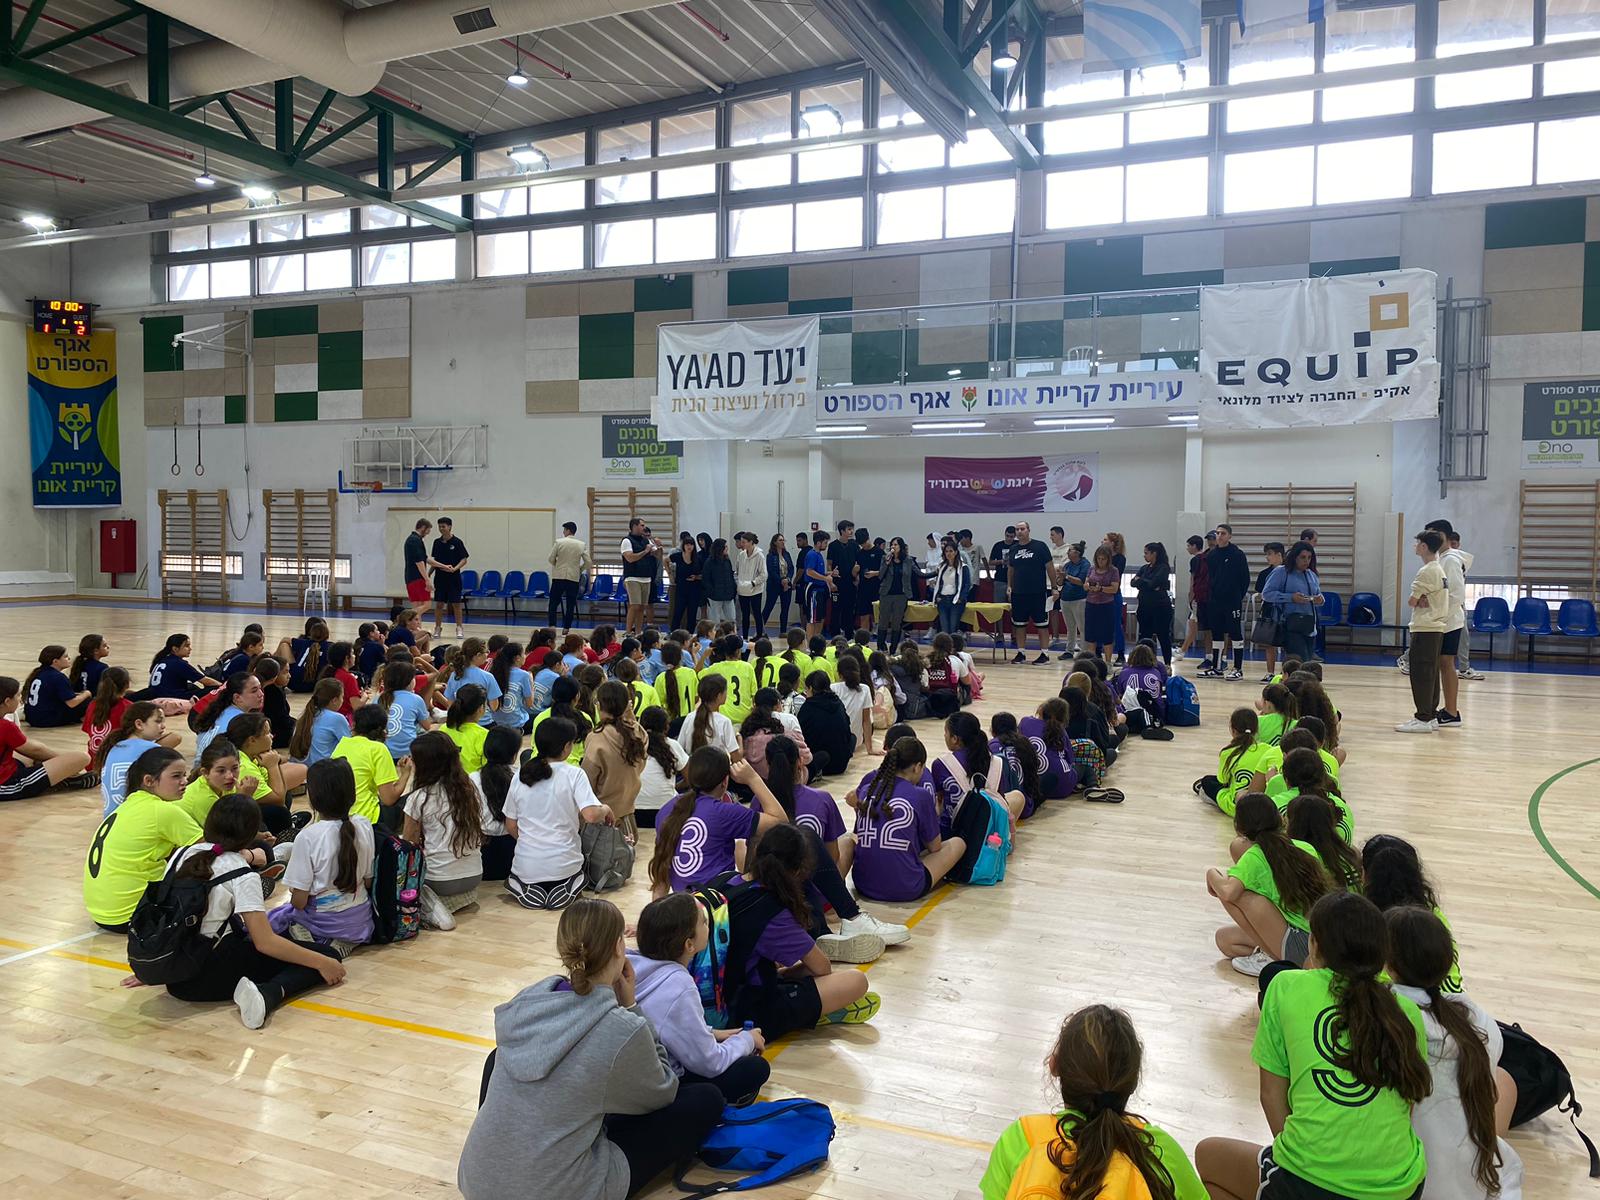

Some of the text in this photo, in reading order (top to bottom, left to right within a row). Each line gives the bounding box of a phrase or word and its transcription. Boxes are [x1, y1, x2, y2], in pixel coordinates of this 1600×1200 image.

[44, 323, 85, 336] 1 2
[53, 338, 90, 357] אגף
[36, 357, 108, 373] הספורט
[753, 346, 807, 386] יעד
[824, 380, 1184, 414] עיריית קריית אונו אגף הספורט
[1217, 385, 1411, 406] אקיפ החברה לציוד מלונאי
[1541, 386, 1574, 395] ספורט
[671, 391, 806, 413] פרזול ועיצוב הבית
[619, 427, 657, 440] חנכים
[617, 441, 667, 455] לספורט
[50, 461, 103, 476] עיריית
[37, 478, 117, 497] קריית אונו
[928, 478, 969, 489] בכדוריד
[1006, 476, 1033, 488] ליגת
[1231, 610, 1241, 619] 15
[930, 670, 946, 678] VANS
[28, 679, 42, 706] 9
[683, 685, 692, 713] 1
[730, 675, 741, 707] 3
[856, 797, 914, 851] 42
[88, 812, 117, 879] 8
[671, 816, 708, 878] 3
